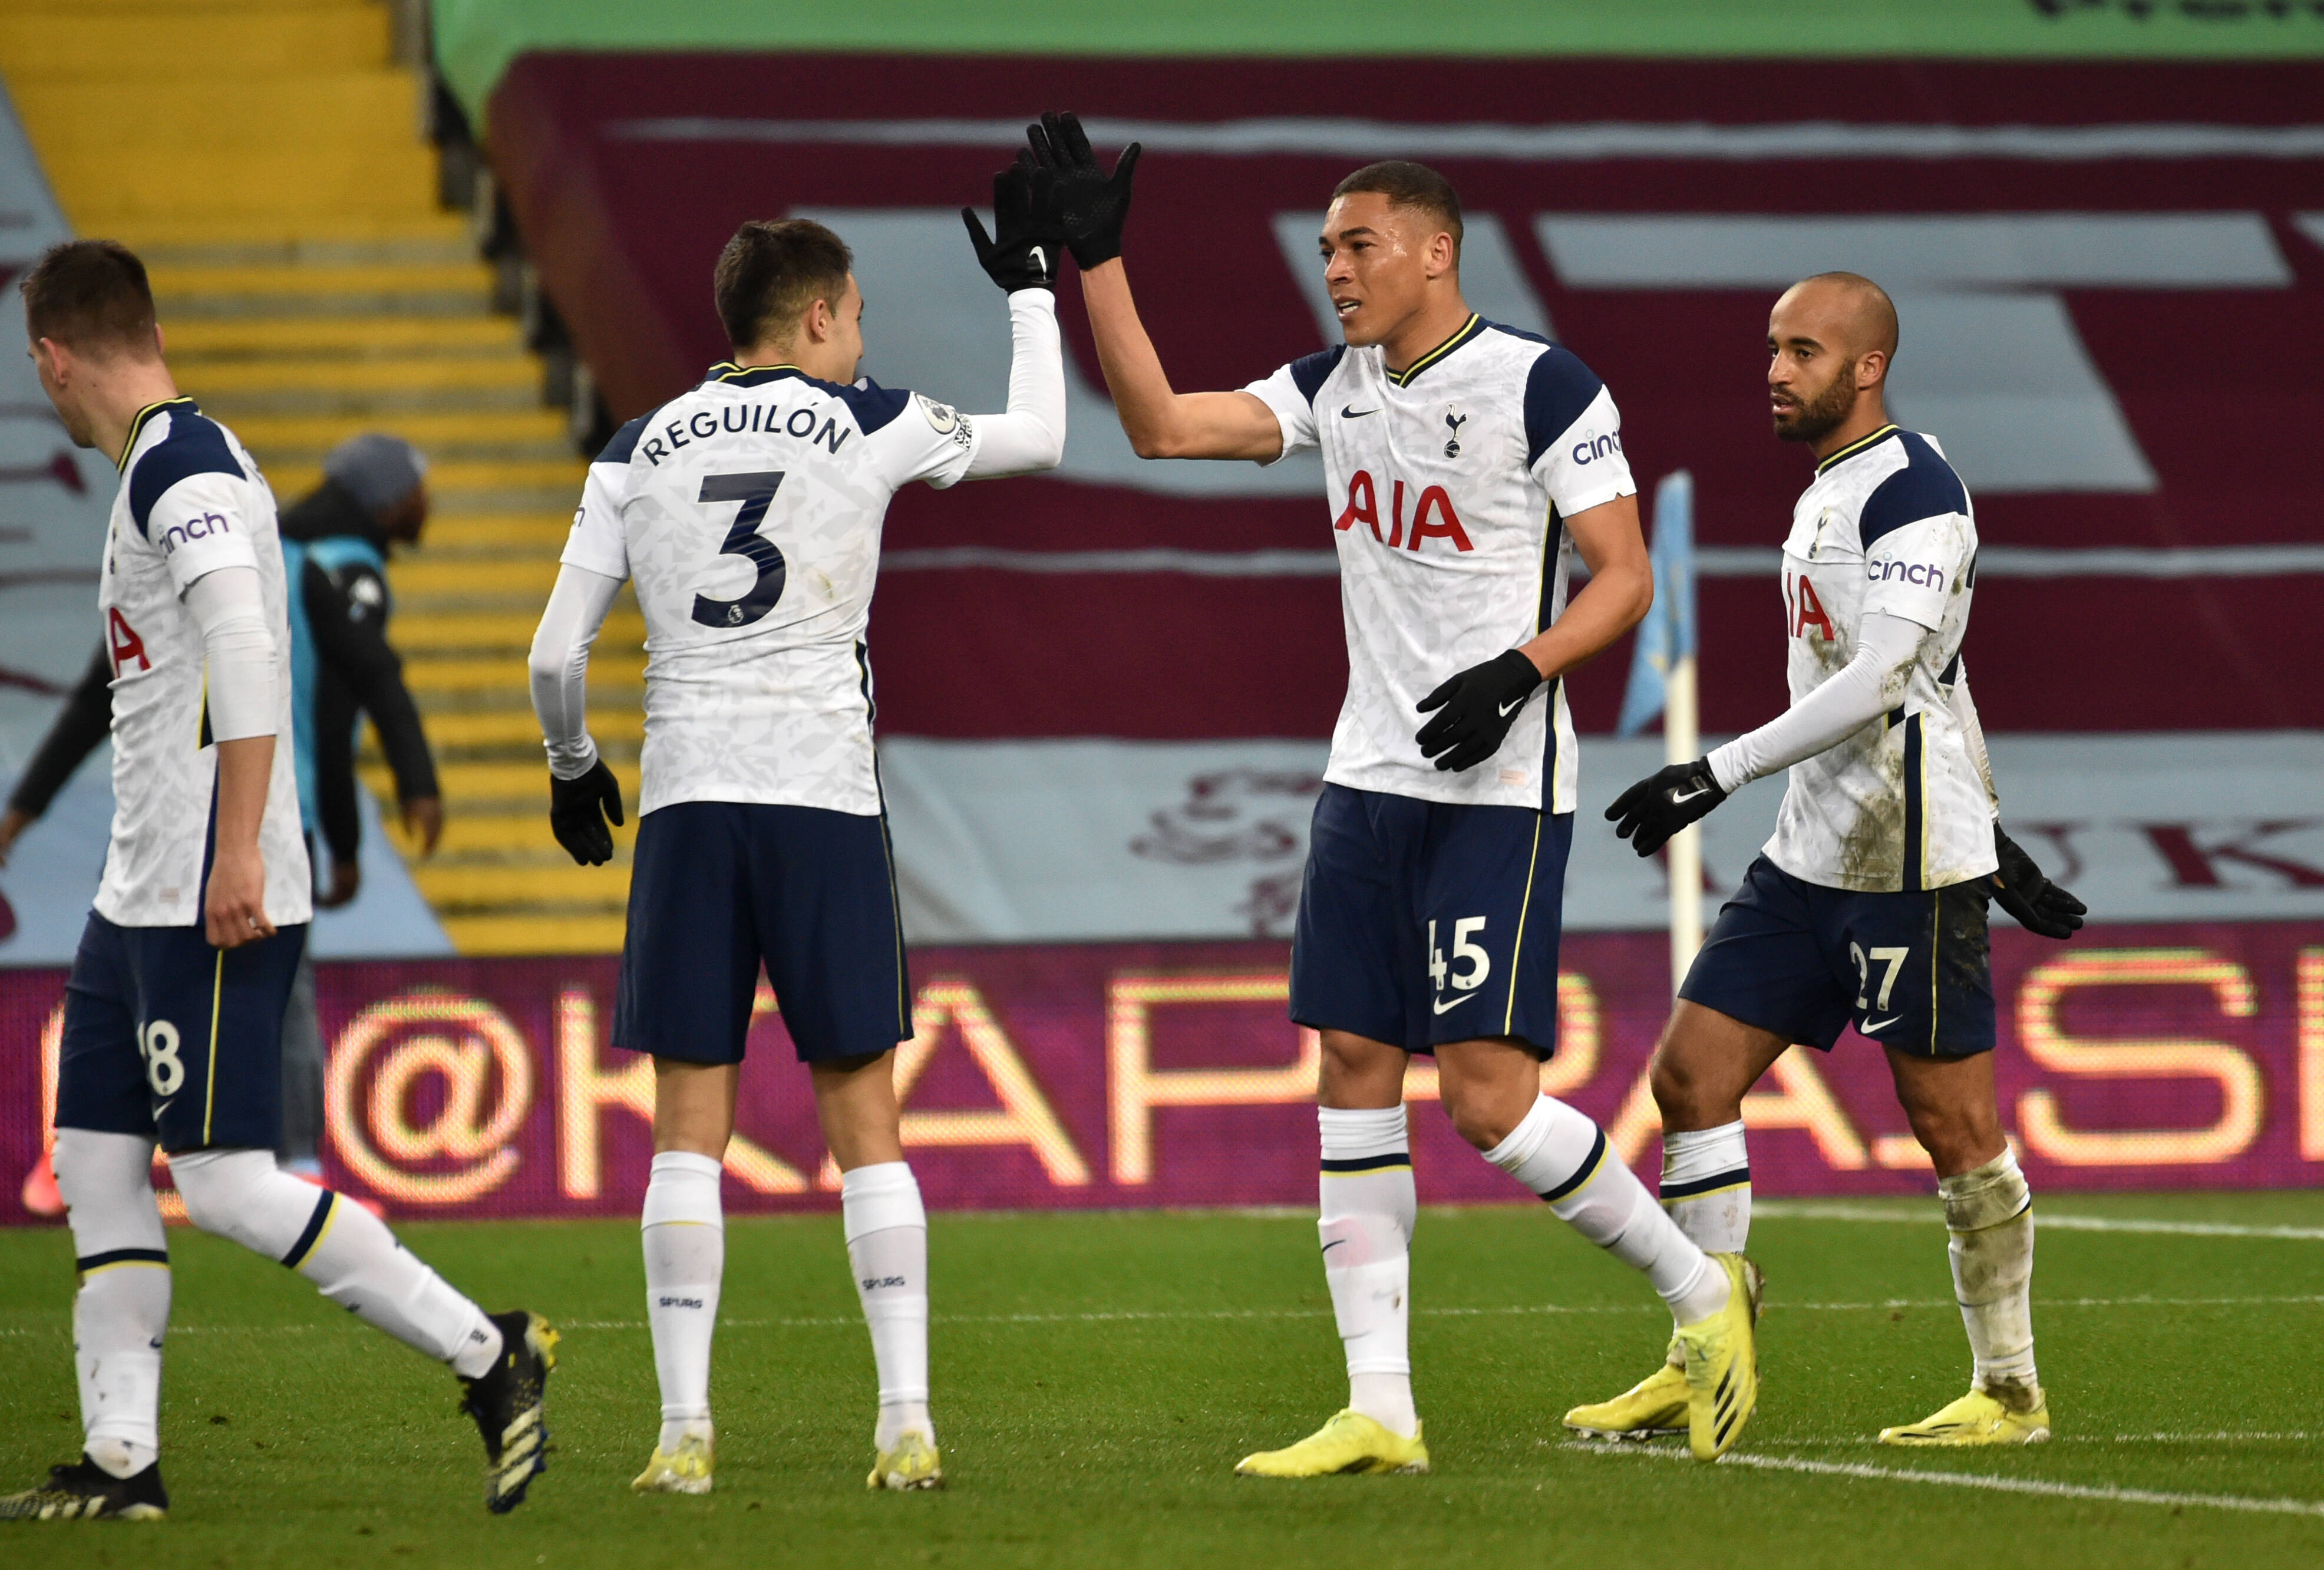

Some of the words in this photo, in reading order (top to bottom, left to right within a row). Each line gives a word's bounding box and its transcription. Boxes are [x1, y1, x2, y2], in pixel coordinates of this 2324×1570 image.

[642, 402, 850, 466] REGUILÓN
[1572, 428, 1621, 465] cinc
[159, 512, 229, 556] inch
[1335, 470, 1474, 552] AIA
[691, 471, 786, 628] 3
[1868, 551, 1944, 592] cinch
[1428, 916, 1490, 990] 45
[1850, 941, 1909, 1011] 27
[324, 945, 2324, 1203] @KAPPA_S
